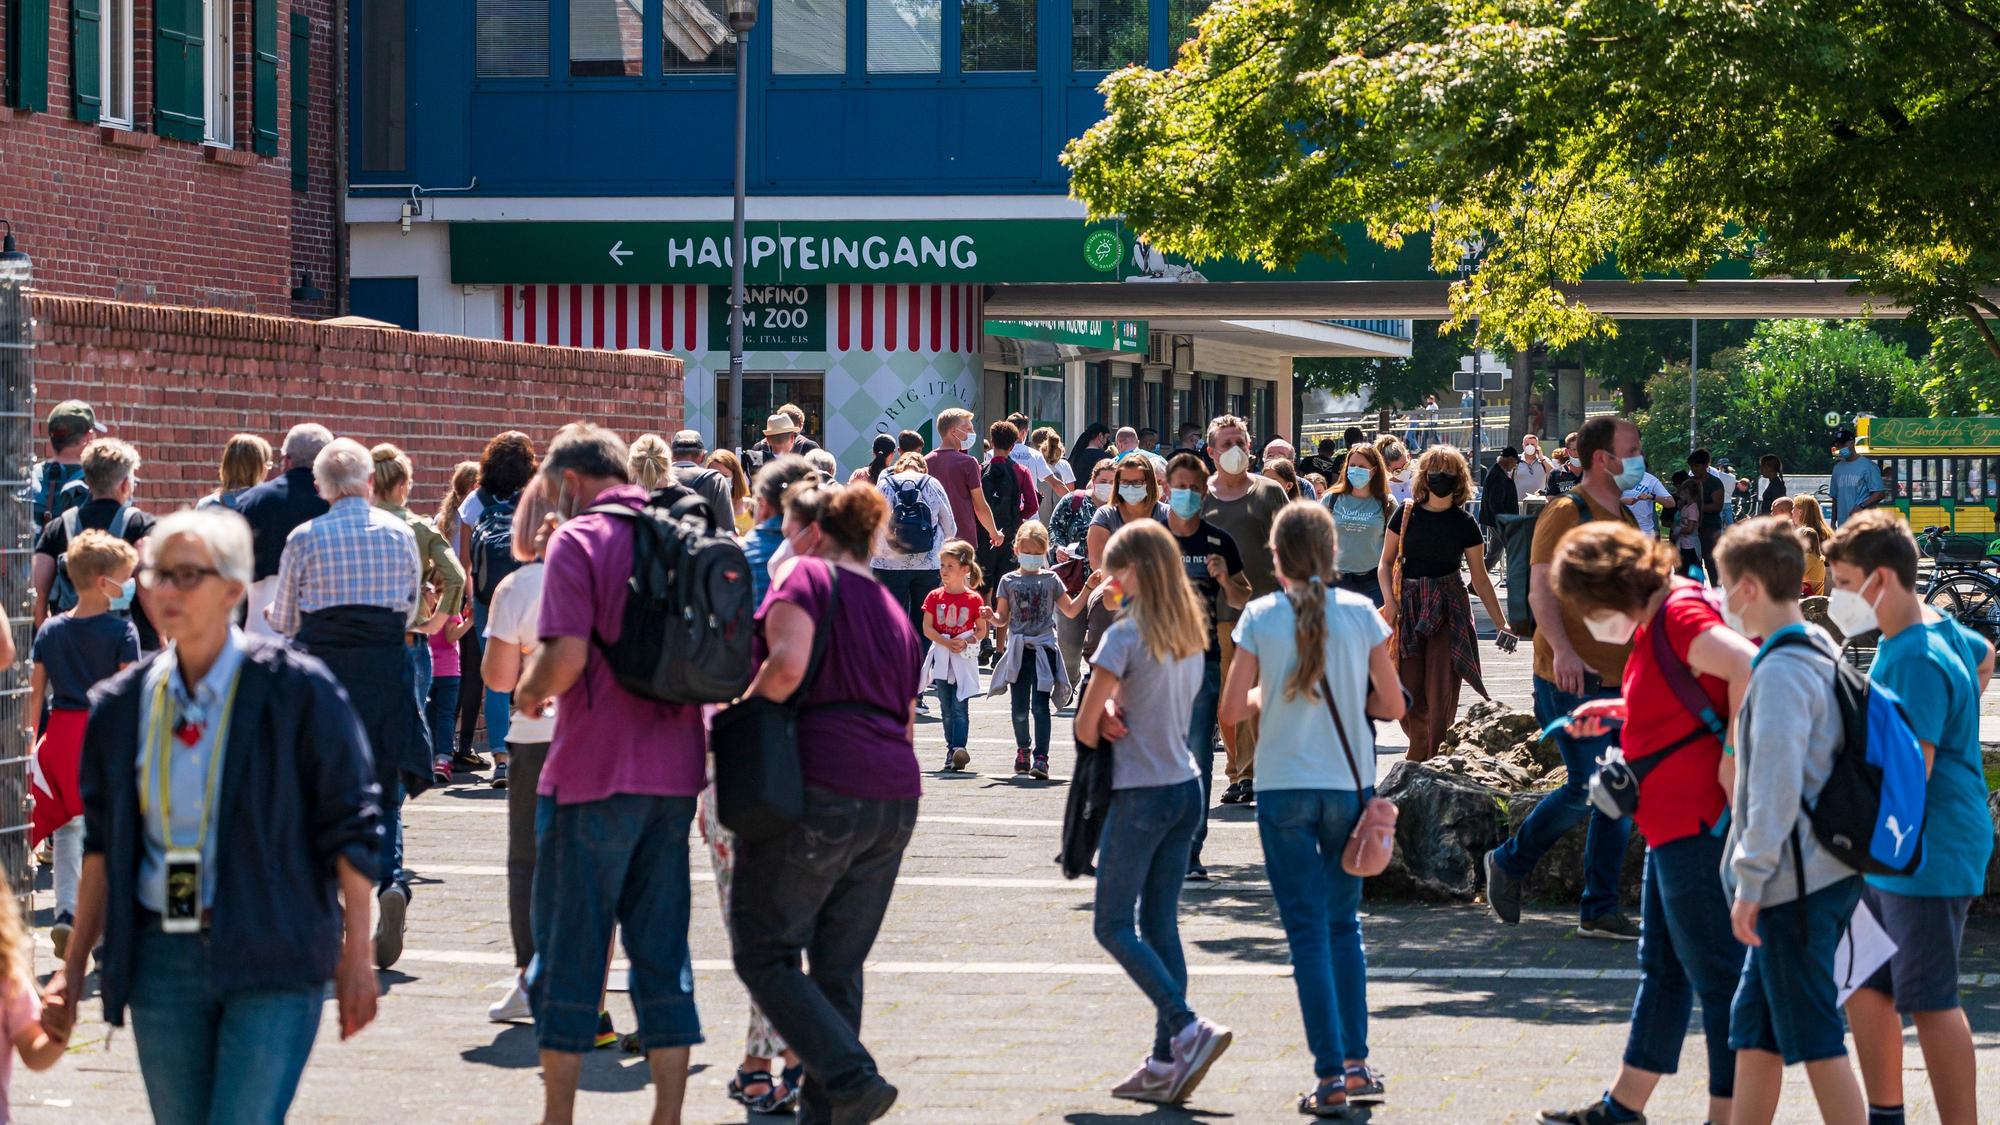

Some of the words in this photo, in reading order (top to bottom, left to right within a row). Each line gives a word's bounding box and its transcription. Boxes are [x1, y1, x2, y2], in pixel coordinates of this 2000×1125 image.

[668, 236, 977, 270] HAUPTEINGANG
[763, 308, 808, 328] ZOO
[791, 335, 808, 343] EIS
[1828, 415, 1837, 425] H
